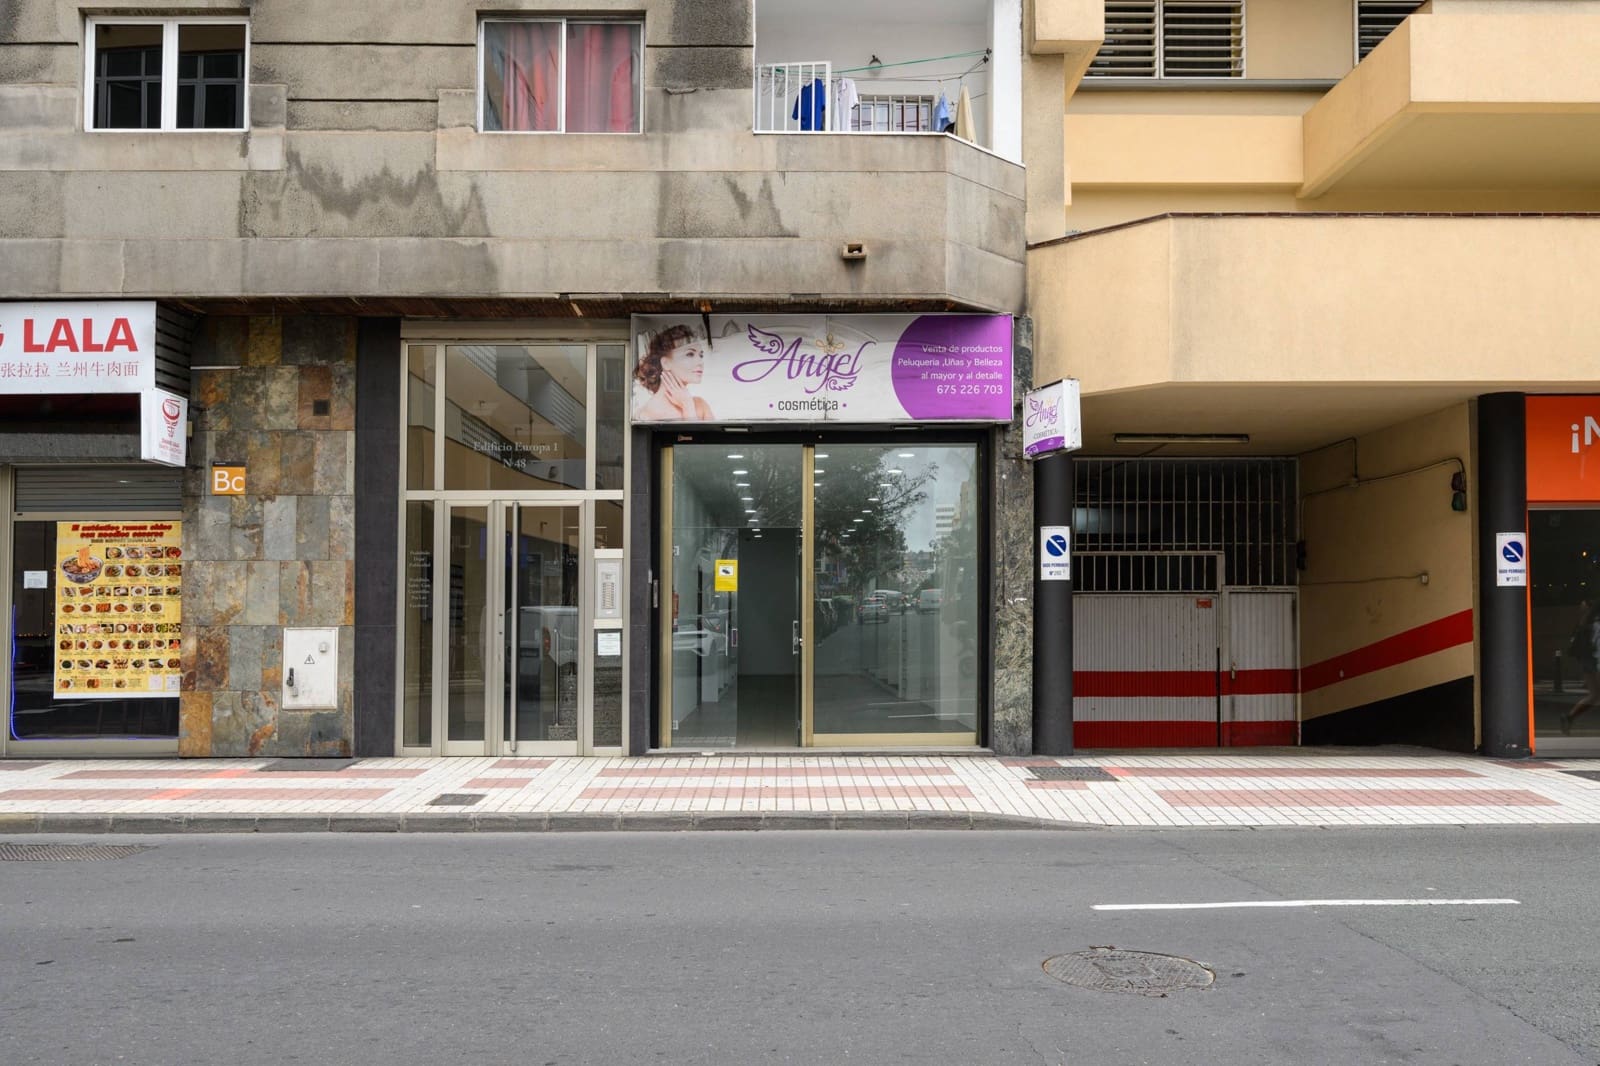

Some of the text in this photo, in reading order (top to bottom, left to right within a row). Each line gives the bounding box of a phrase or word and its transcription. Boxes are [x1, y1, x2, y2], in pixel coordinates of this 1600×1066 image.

[23, 317, 139, 353] LALA
[921, 345, 1003, 354] Venta de productos
[0, 360, 140, 378] 张拉拉 兰州牛肉面
[731, 336, 877, 394] Angel
[974, 358, 1003, 367] Belleza
[921, 371, 1003, 381] al mayor y al detalle
[936, 384, 1004, 395] 675 226 703
[777, 397, 839, 411] cosmética
[473, 441, 559, 454] Edificio Europa 1
[214, 470, 244, 491] Bc
